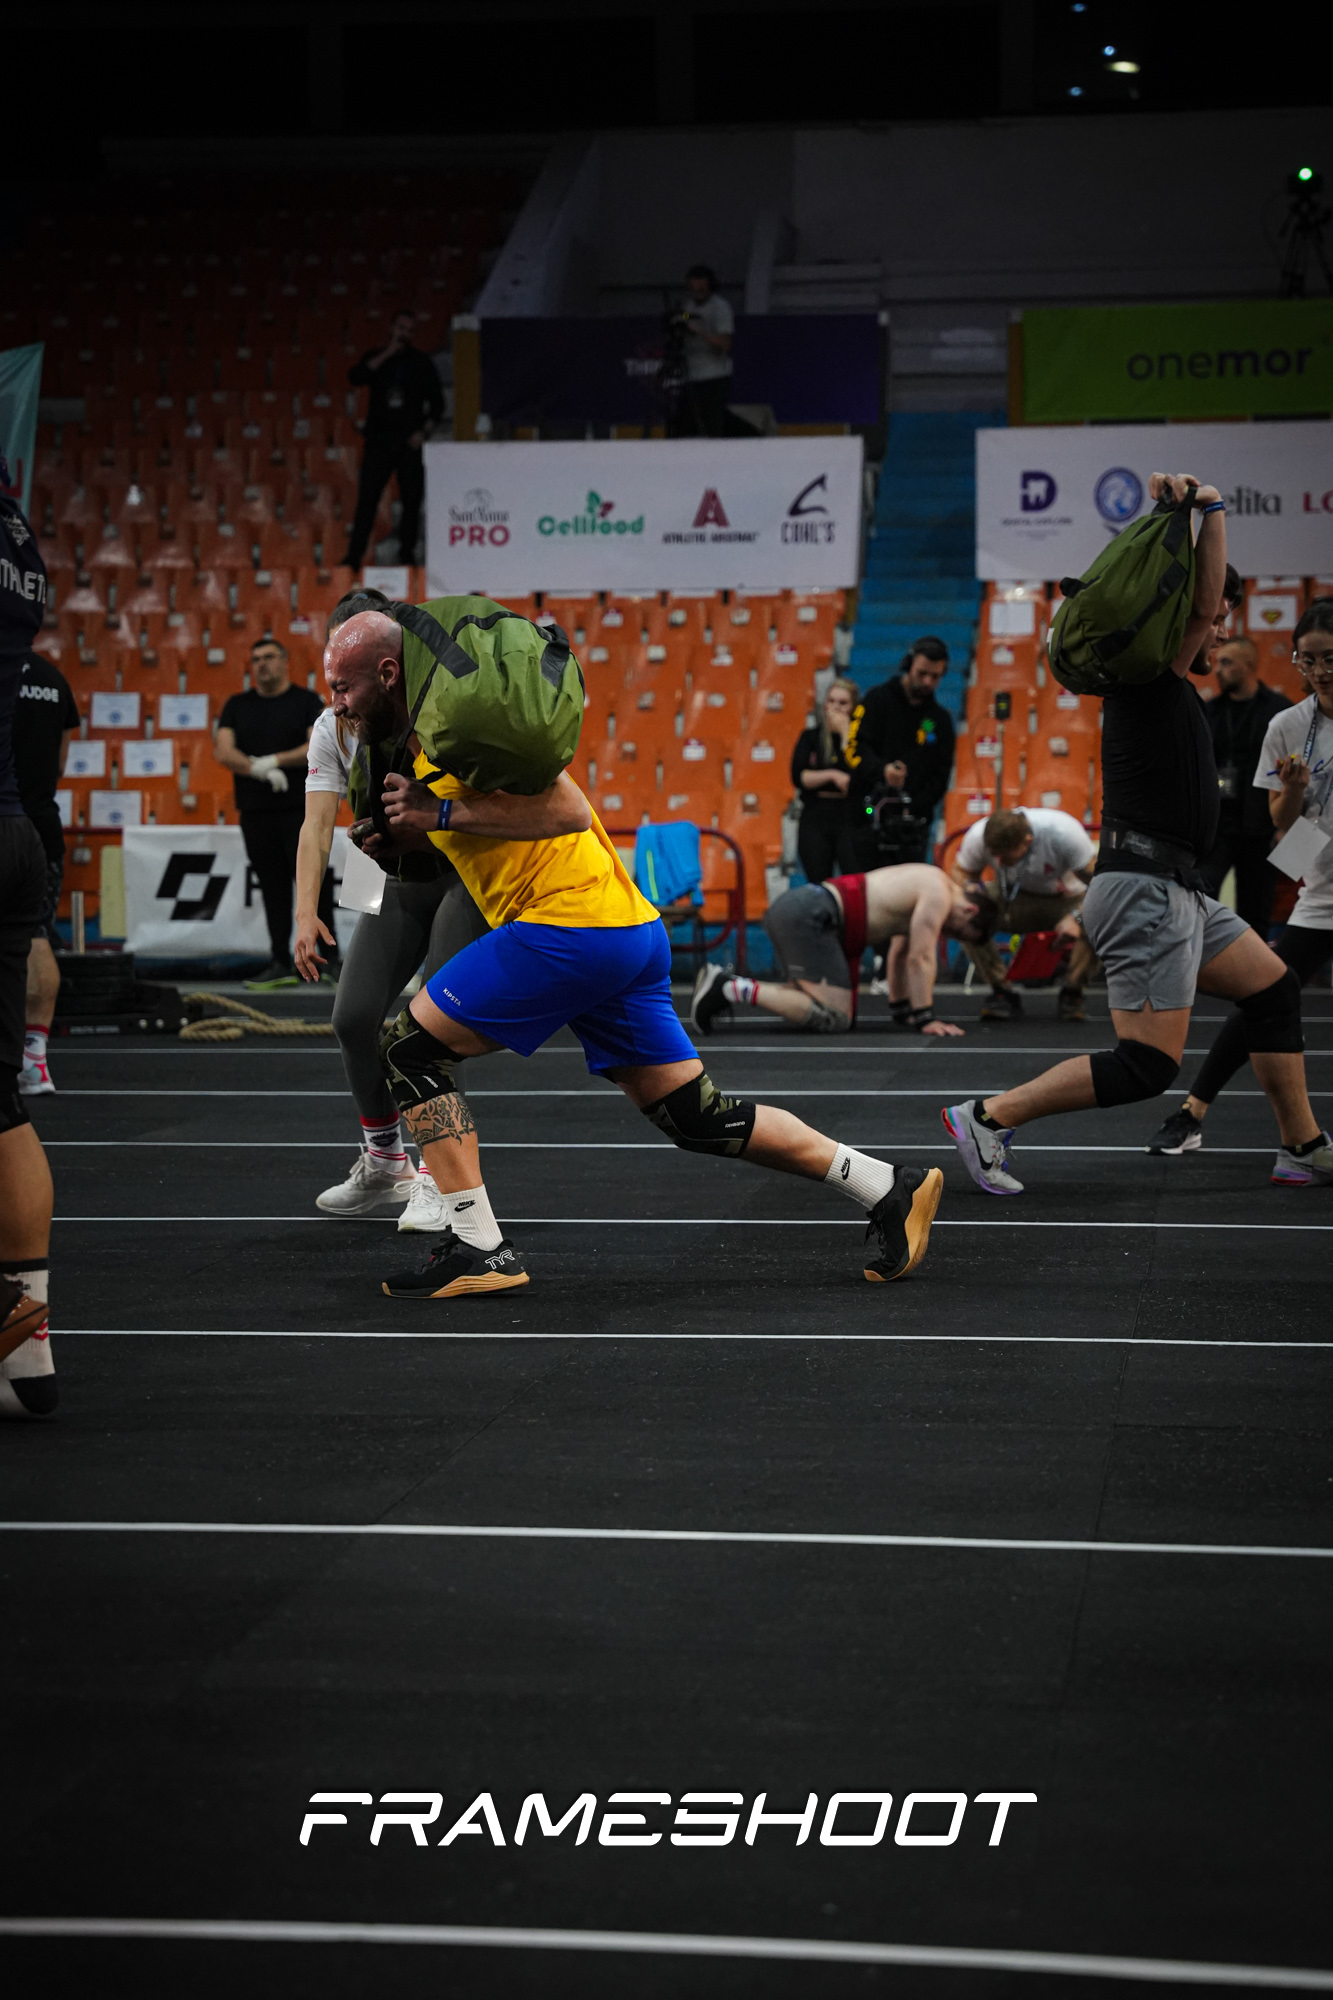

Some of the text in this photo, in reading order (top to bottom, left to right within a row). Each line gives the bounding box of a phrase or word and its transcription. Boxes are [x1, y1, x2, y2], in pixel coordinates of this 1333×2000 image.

[1126, 347, 1312, 381] onemor
[1220, 485, 1281, 517] elita
[449, 525, 510, 547] PRO
[0, 558, 46, 604] THLET
[20, 685, 59, 703] JUDGE
[443, 987, 462, 1006] KIPSTA
[485, 1248, 516, 1270] TYR
